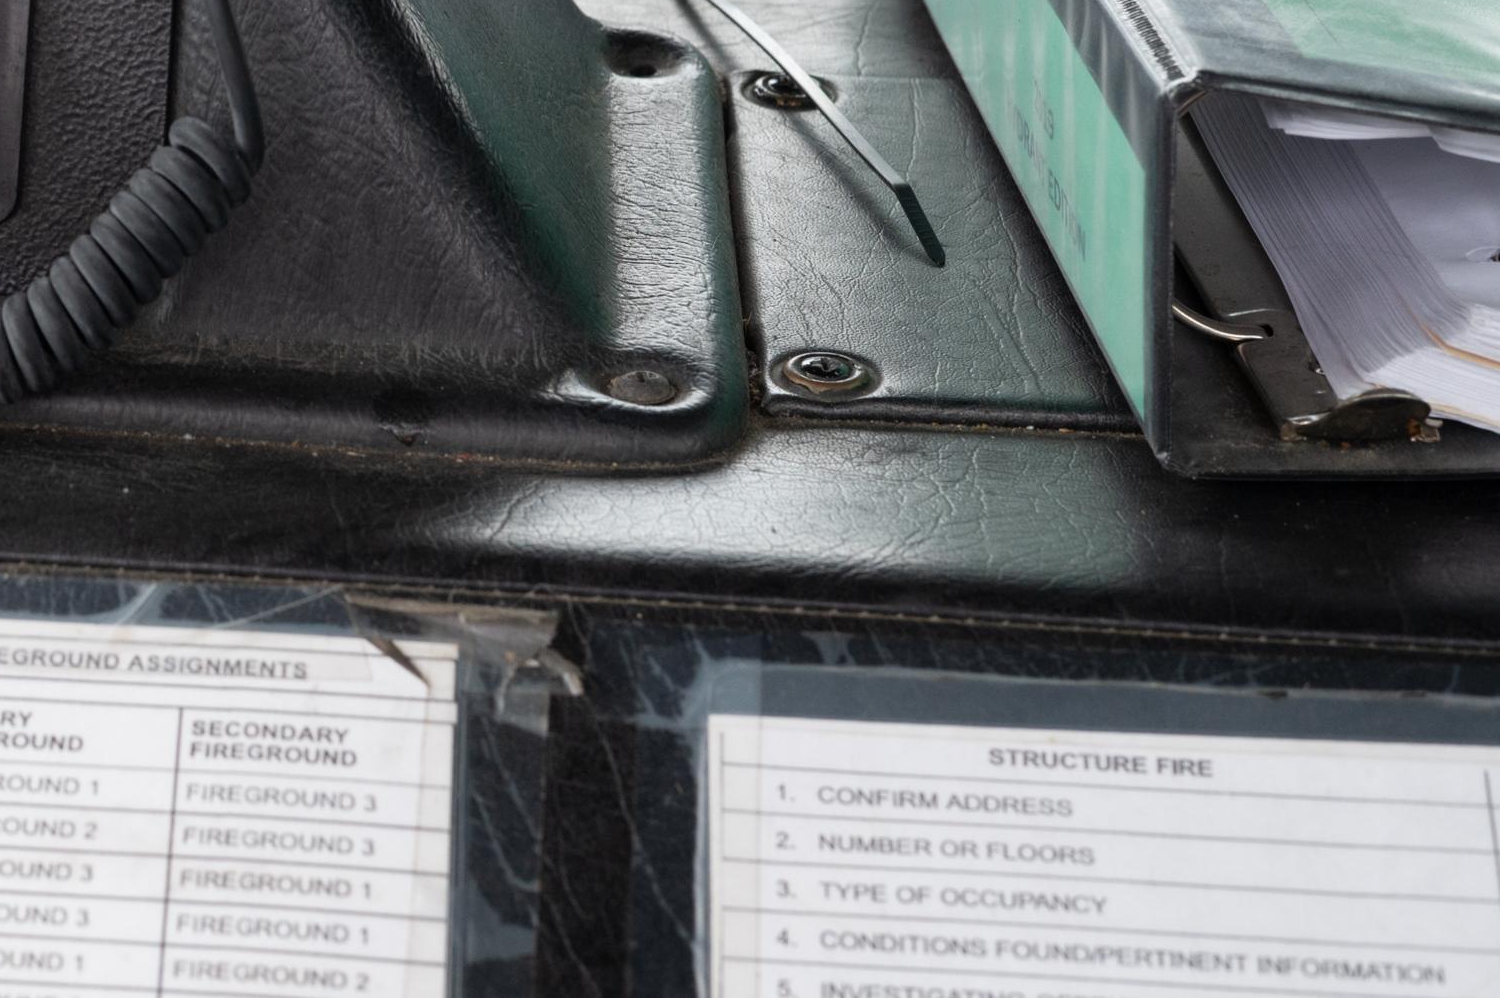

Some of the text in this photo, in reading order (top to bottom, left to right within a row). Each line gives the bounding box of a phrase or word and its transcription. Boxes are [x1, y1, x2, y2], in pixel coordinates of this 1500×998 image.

[127, 654, 308, 680] ASSIGNMENTS
[192, 720, 349, 744] SECONDARY
[190, 742, 357, 767] FIREGROUND
[989, 748, 1213, 777] STRUCTURE FIRE
[90, 779, 99, 796] 1
[186, 783, 378, 813] FIREGROUND 3
[777, 784, 1074, 817] 1. CONFIRM ADDRESS
[84, 822, 98, 841] 2
[182, 826, 376, 856] FIREGROUND 3
[775, 831, 1096, 866] 2. NUMBER OR FLOORS
[80, 864, 94, 882] 3
[179, 869, 371, 900] FIREGROUND 1
[776, 879, 1107, 914] 3. TYPE OF OCCUPANCY
[76, 908, 90, 927] 3
[175, 913, 369, 945] FIREGROUND 1
[73, 954, 85, 972] 1
[776, 928, 798, 948] 4.
[819, 929, 988, 958] CONDITIONS
[1256, 955, 1447, 985] INFORMATION
[173, 959, 370, 991] FIREGROUND 2
